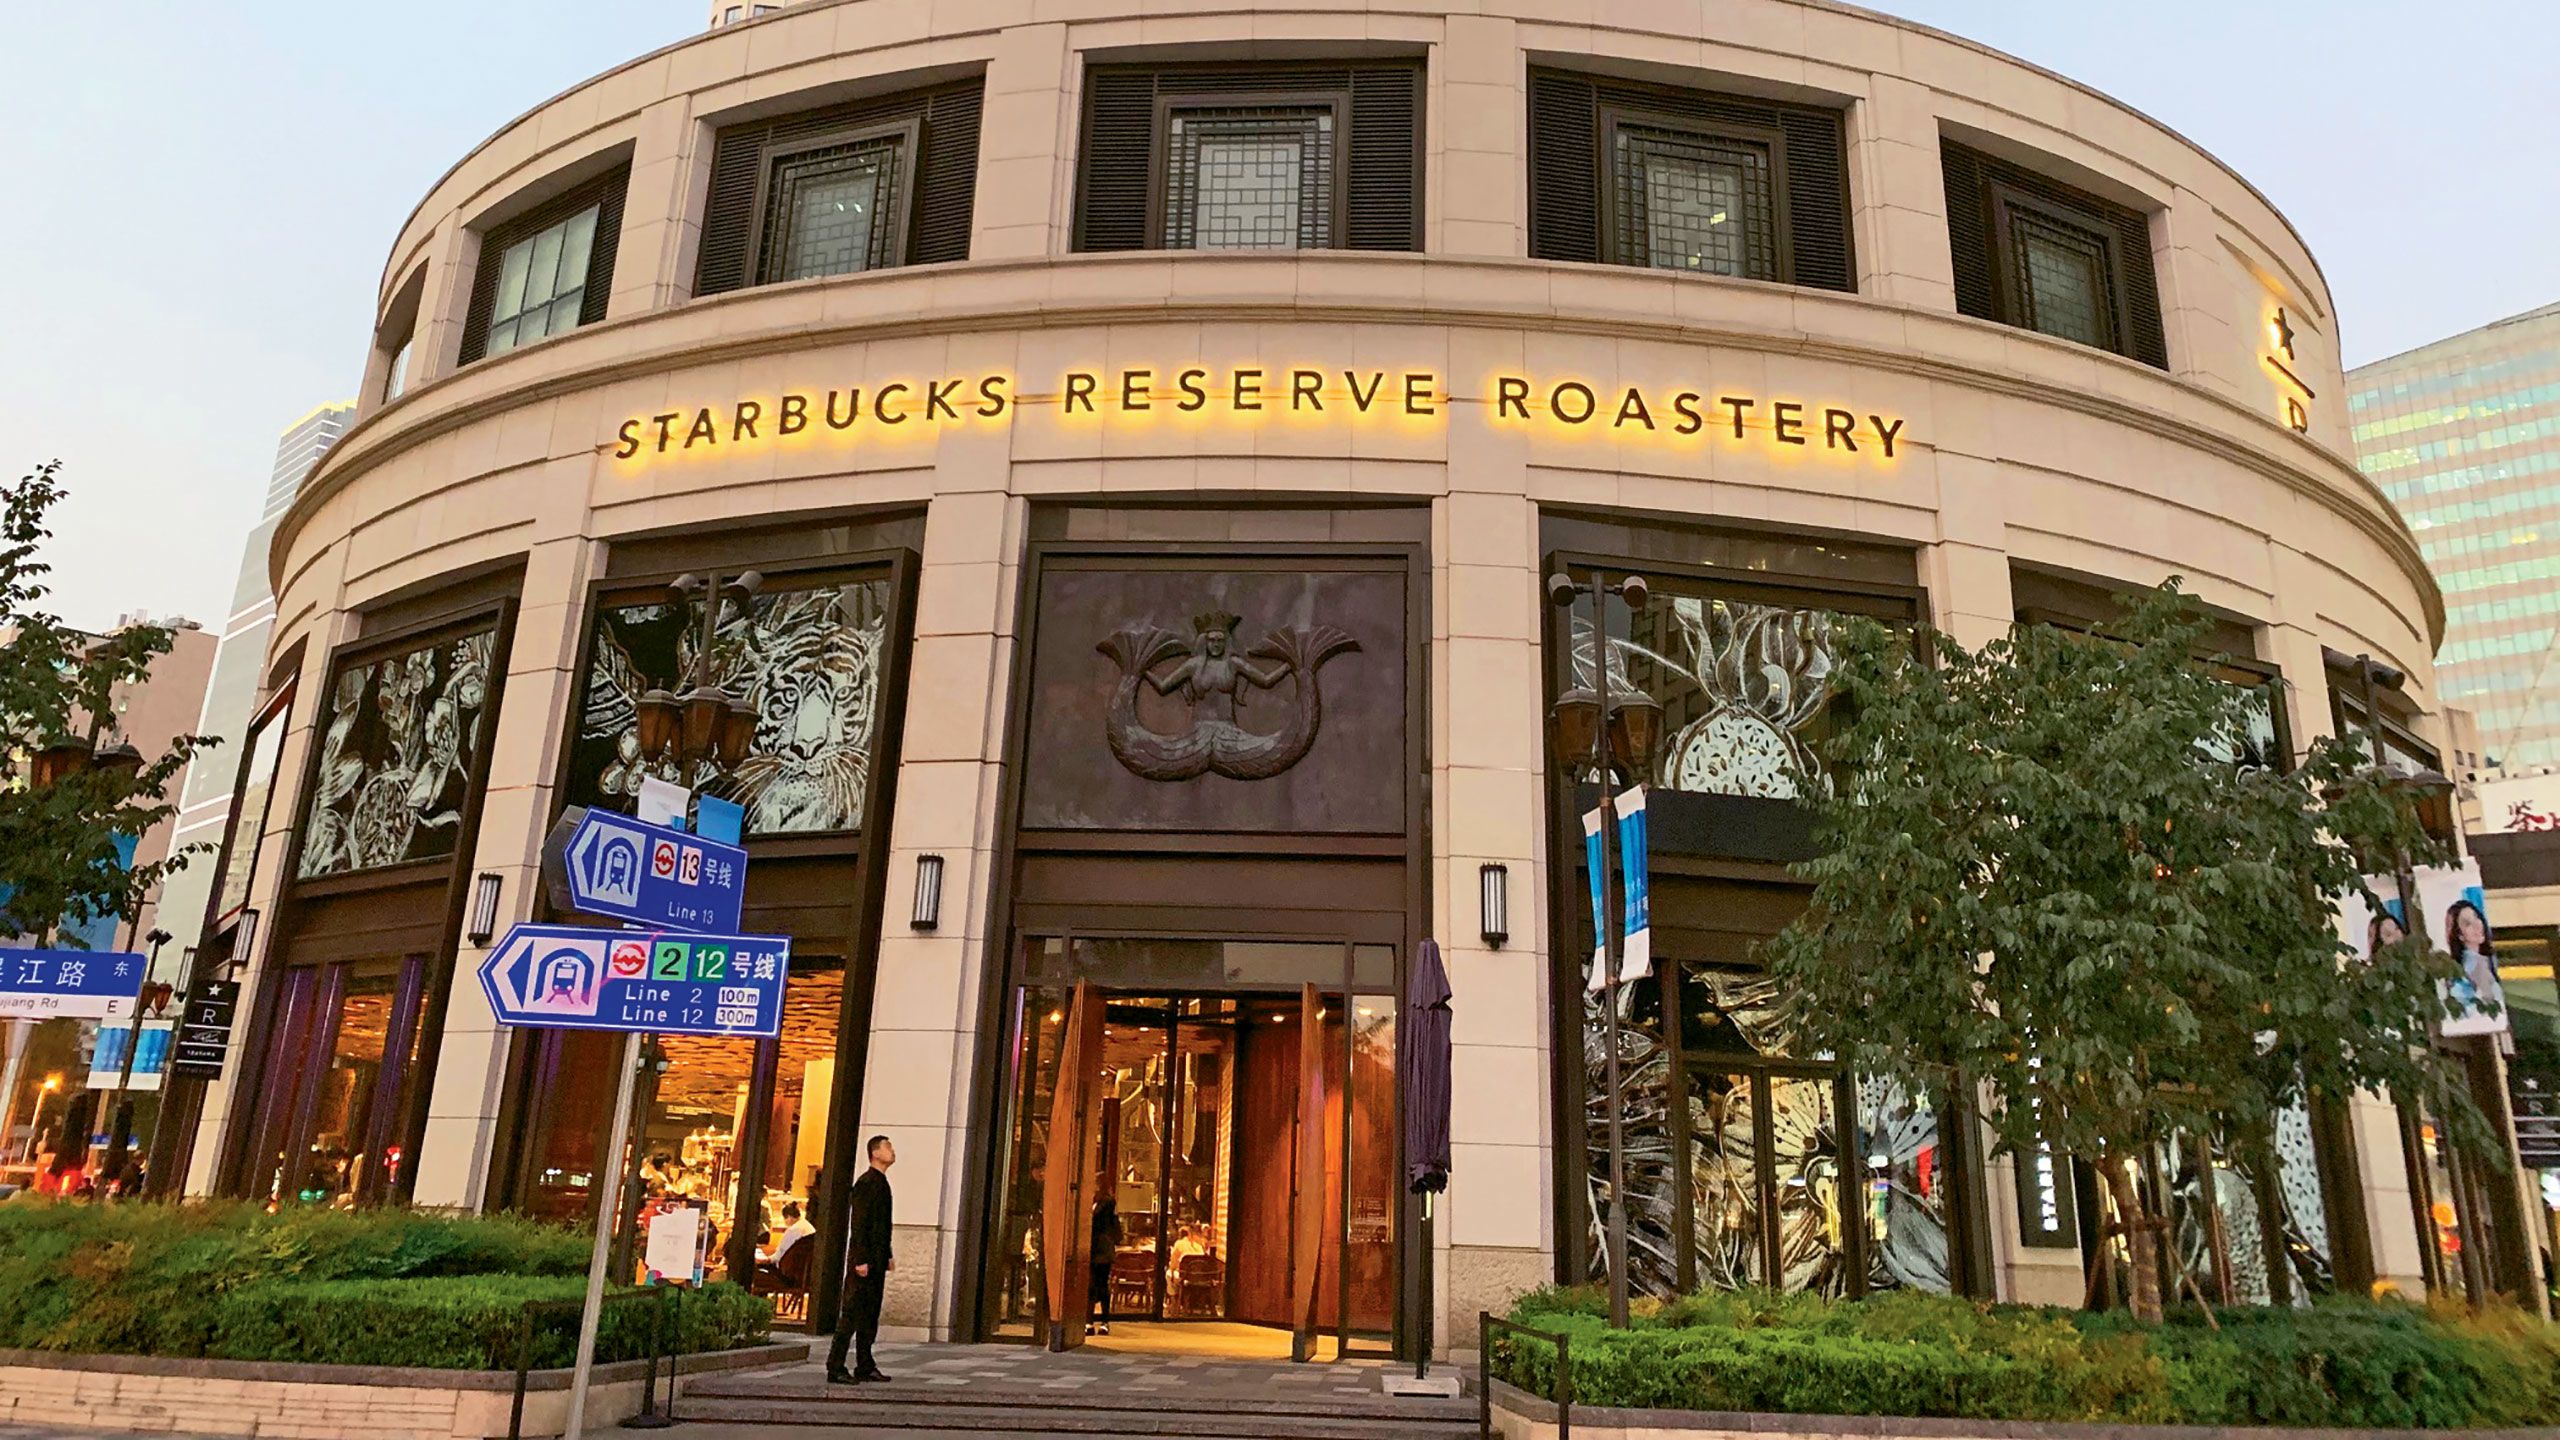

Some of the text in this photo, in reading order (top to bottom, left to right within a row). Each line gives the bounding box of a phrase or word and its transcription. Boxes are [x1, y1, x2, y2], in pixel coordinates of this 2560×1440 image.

[615, 369, 1904, 459] STARBUCKS RESERVE ROASTERY
[683, 852, 732, 889] 13 号线
[668, 901, 714, 925] Line 13
[0, 957, 130, 987] 江路 东
[659, 948, 776, 981] 2 12 号线
[41, 997, 59, 1008] Rd
[107, 1000, 118, 1013] E
[625, 984, 758, 1004] Line 2 100m
[202, 1008, 217, 1023] R
[622, 1005, 755, 1025] Line 12 300m
